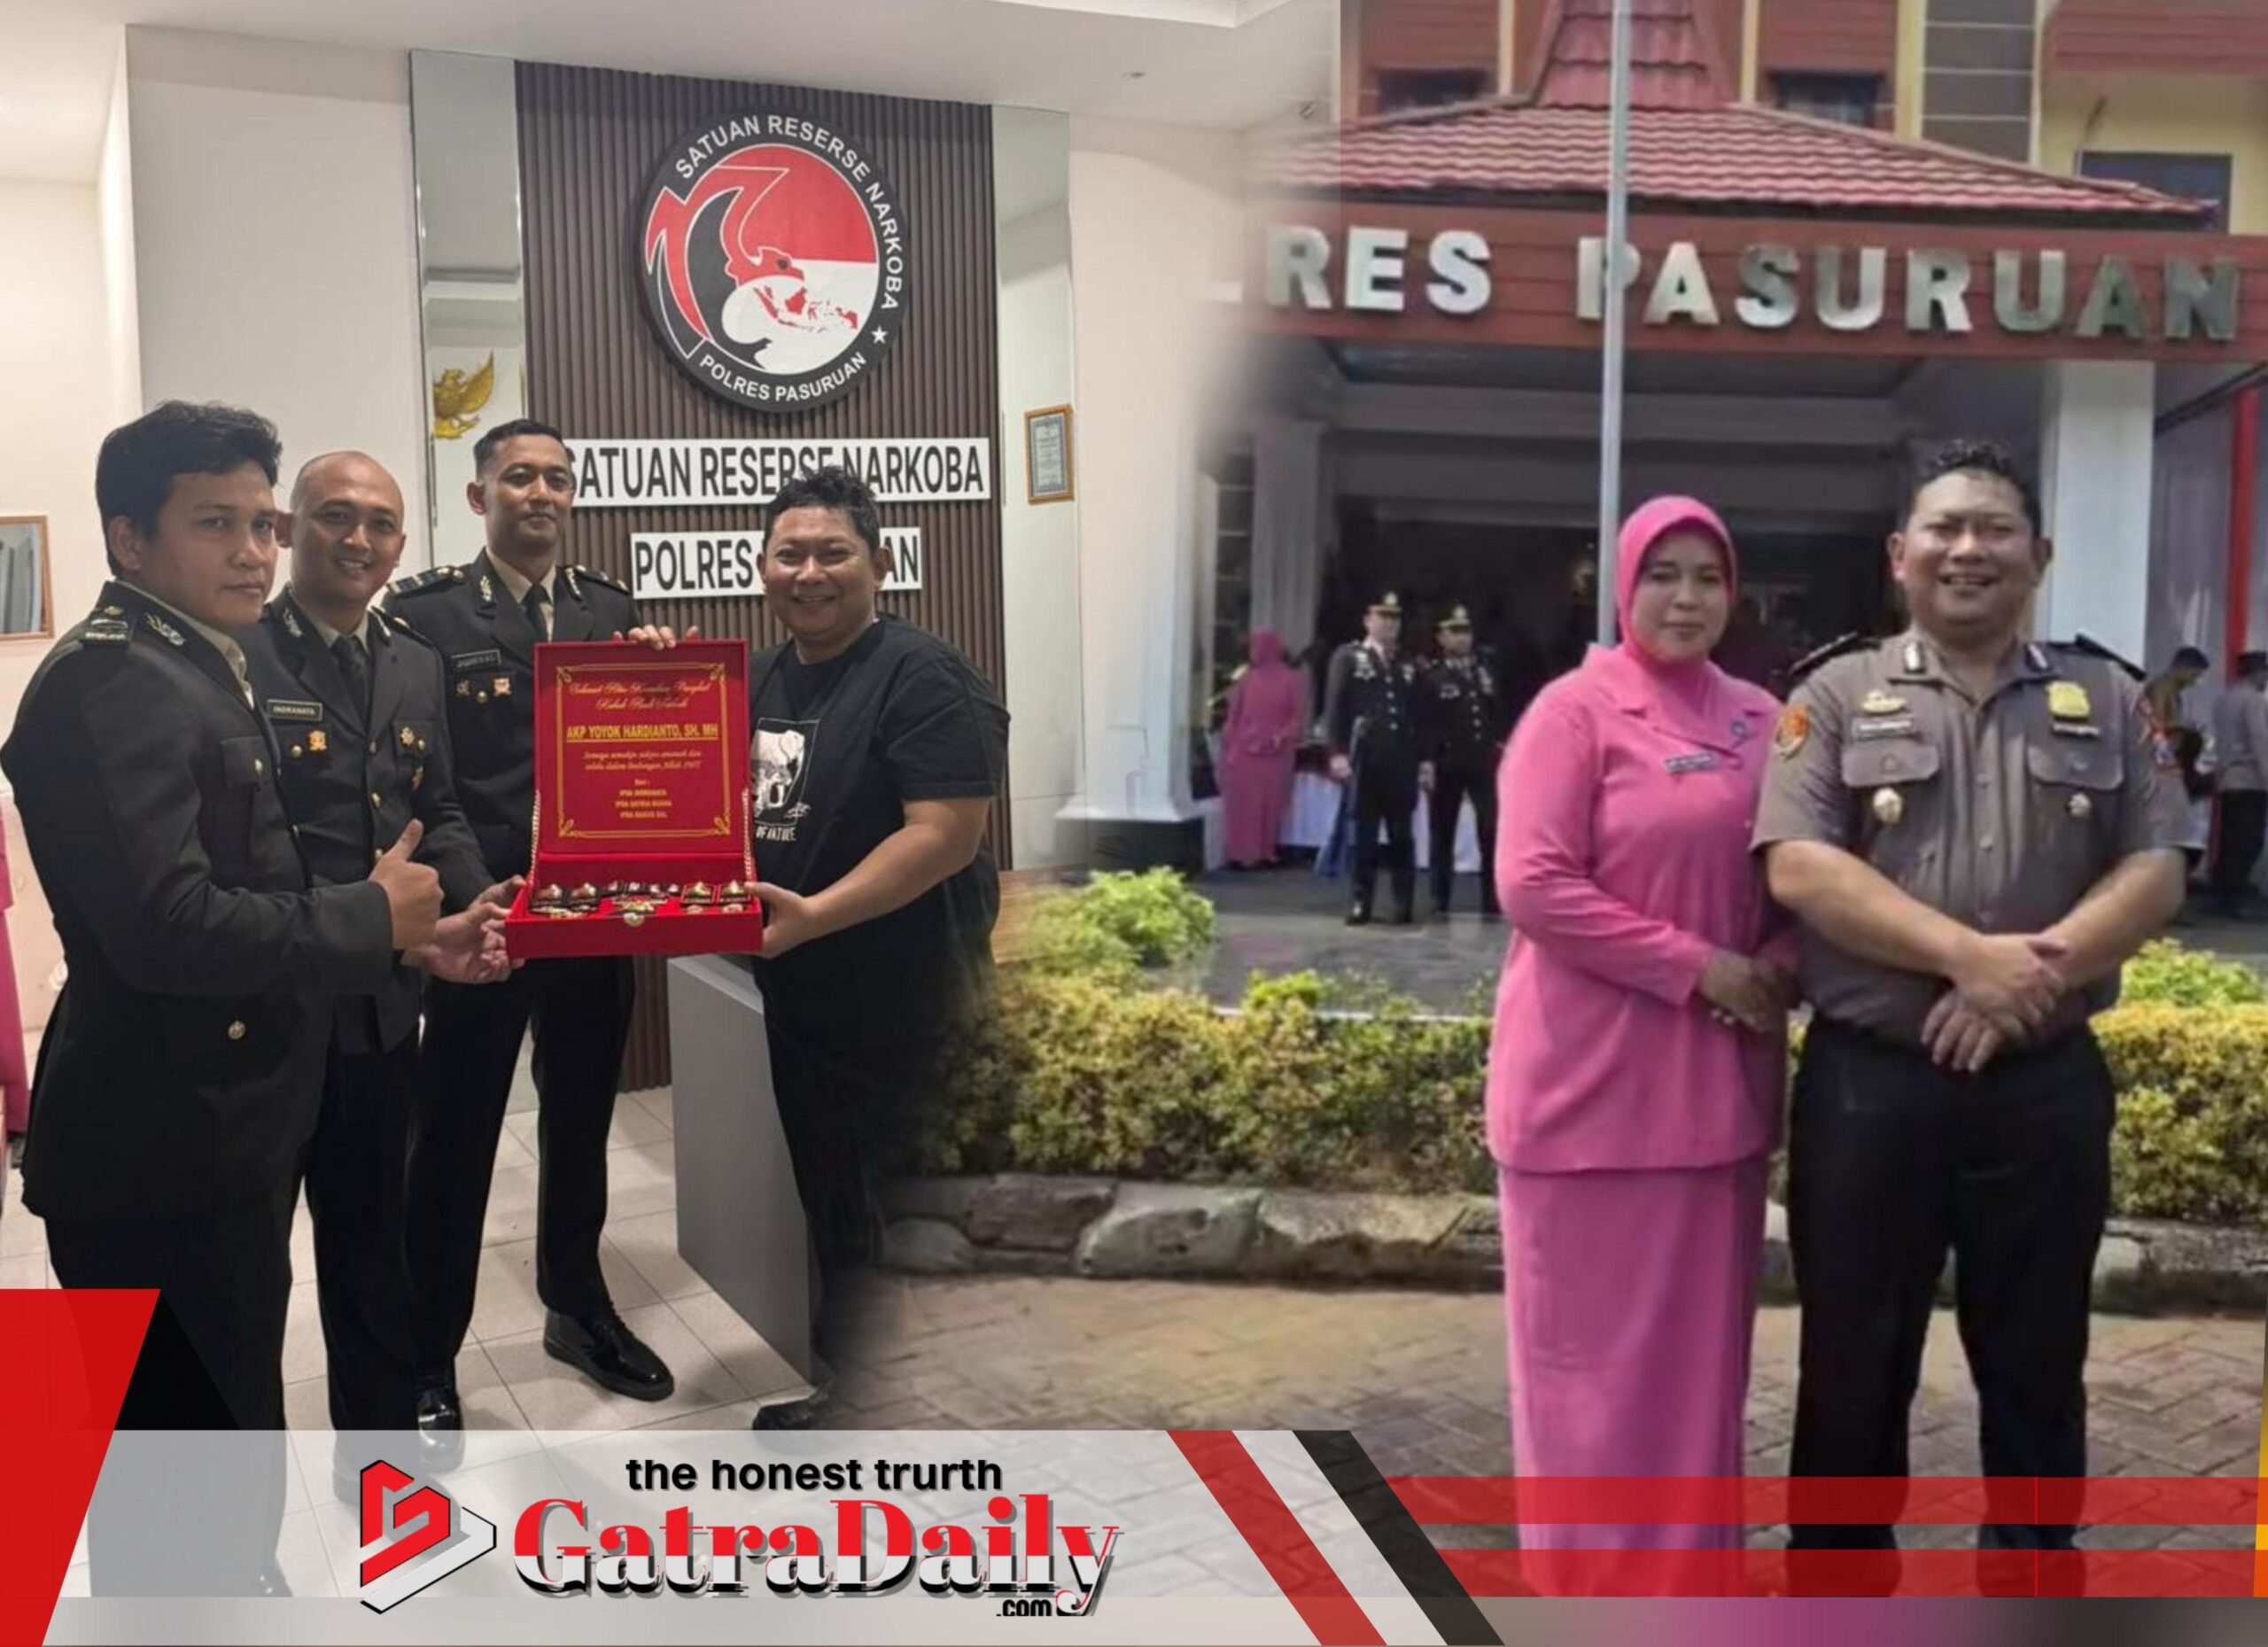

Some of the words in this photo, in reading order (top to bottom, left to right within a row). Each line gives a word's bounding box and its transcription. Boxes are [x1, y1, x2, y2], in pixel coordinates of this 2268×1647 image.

[675, 115, 760, 179] SATUAN
[768, 114, 871, 183] RESERSE
[865, 182, 904, 311] NARKOBA
[1576, 235, 2240, 342] PASURUAN
[699, 353, 771, 400] POLRES
[774, 352, 867, 402] PASURUAN
[842, 444, 984, 494] NARKOBA
[634, 538, 753, 592] POLRES
[566, 725, 586, 739] AKP
[588, 725, 621, 739] YOYOK
